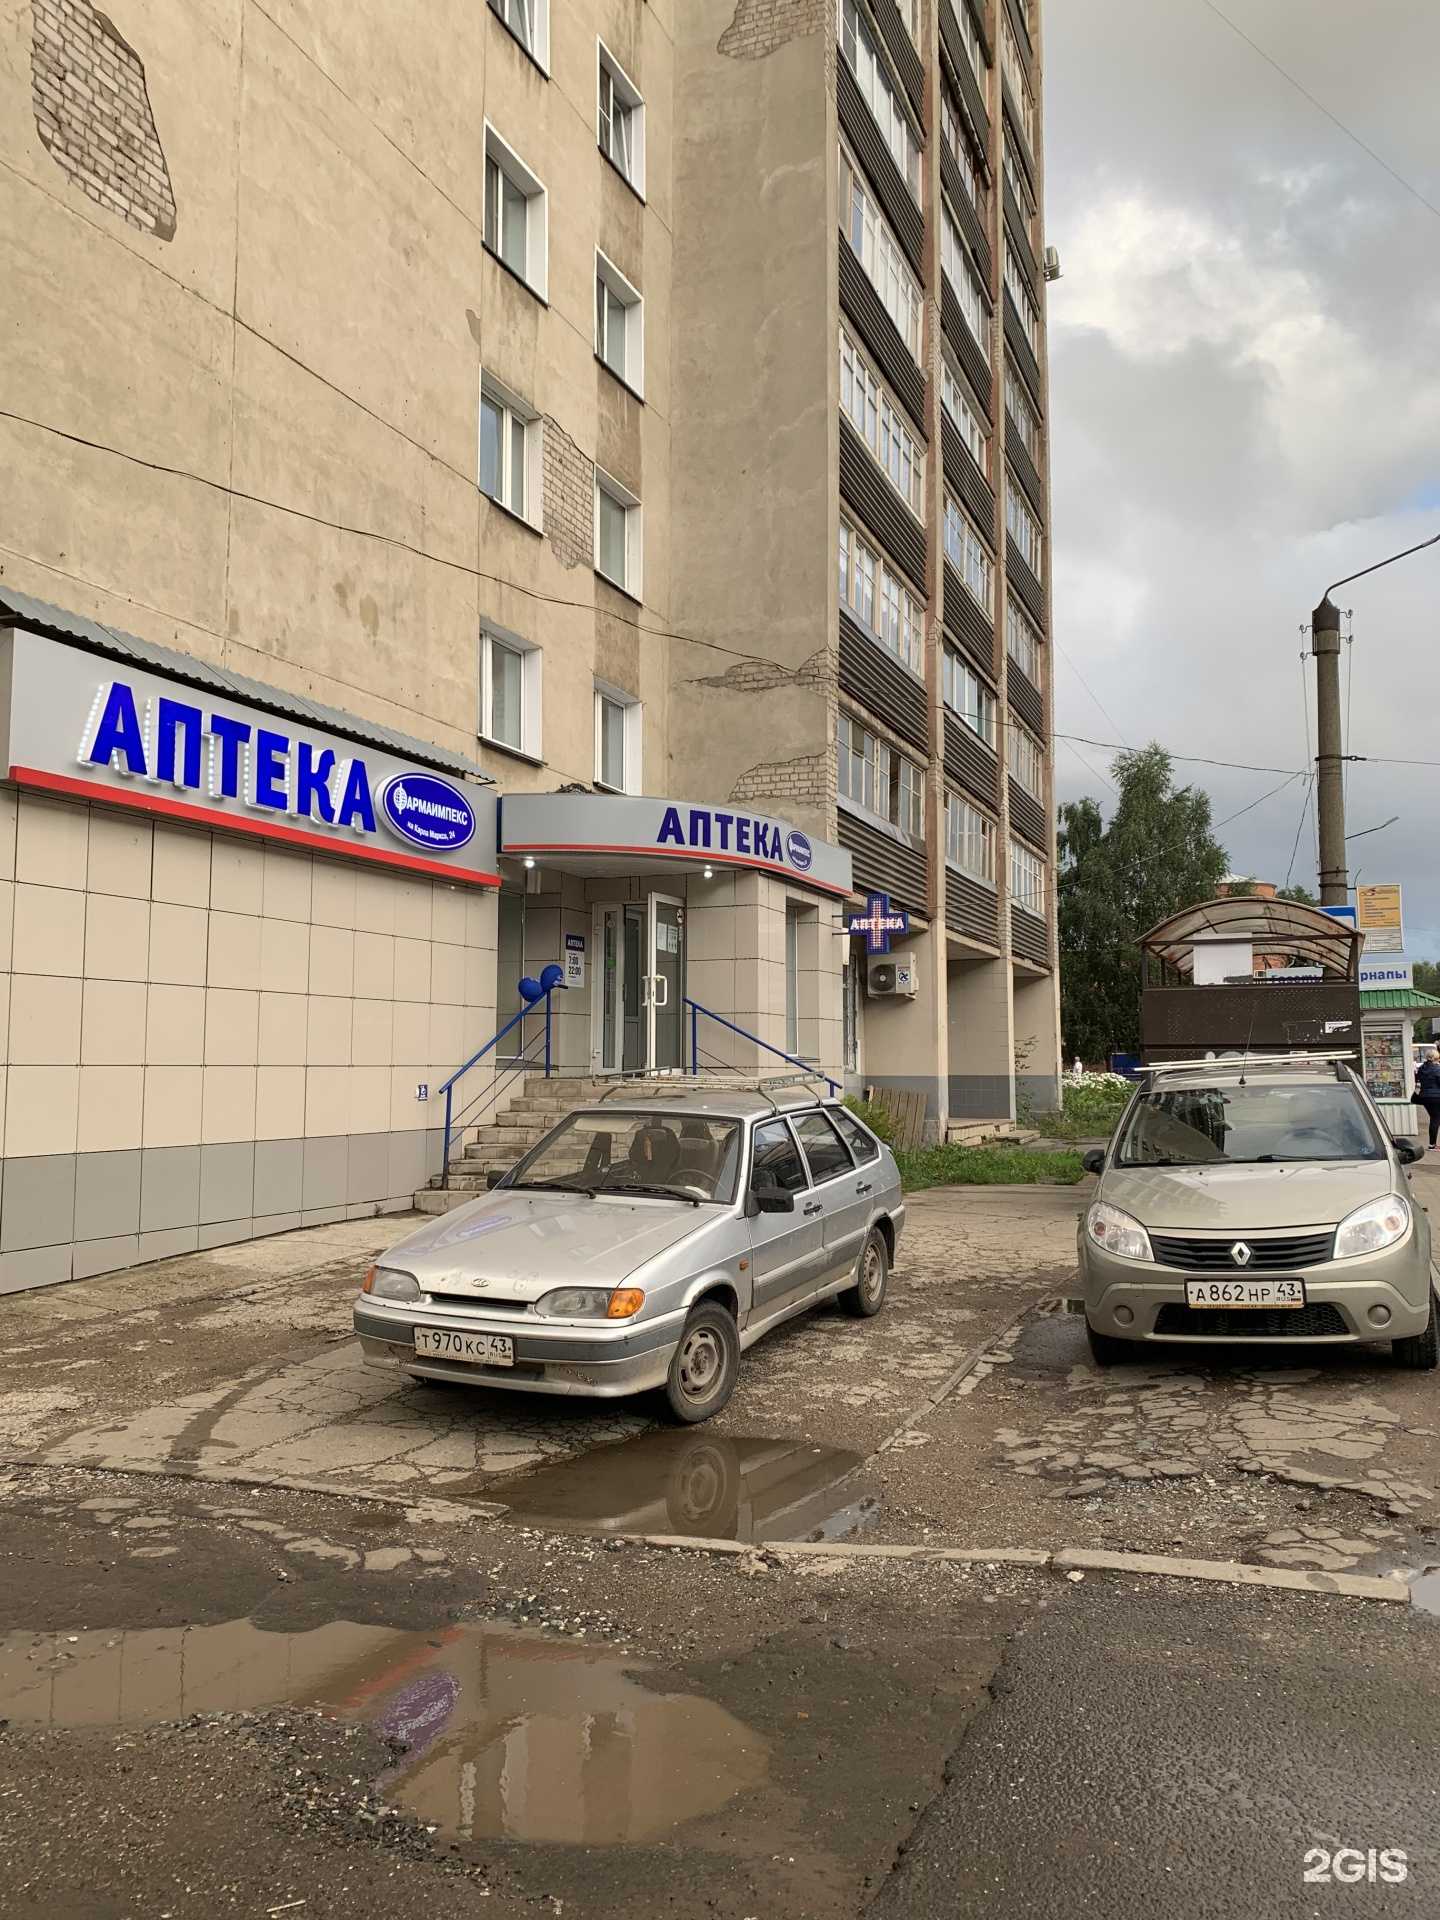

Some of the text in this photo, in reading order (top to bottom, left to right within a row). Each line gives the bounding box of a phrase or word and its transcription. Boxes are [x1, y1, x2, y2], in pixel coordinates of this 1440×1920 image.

[80, 682, 377, 833] АПТЕКА
[448, 830, 456, 839] 24
[656, 807, 784, 861] АПТЕКА
[850, 917, 905, 930] АПТЕКА
